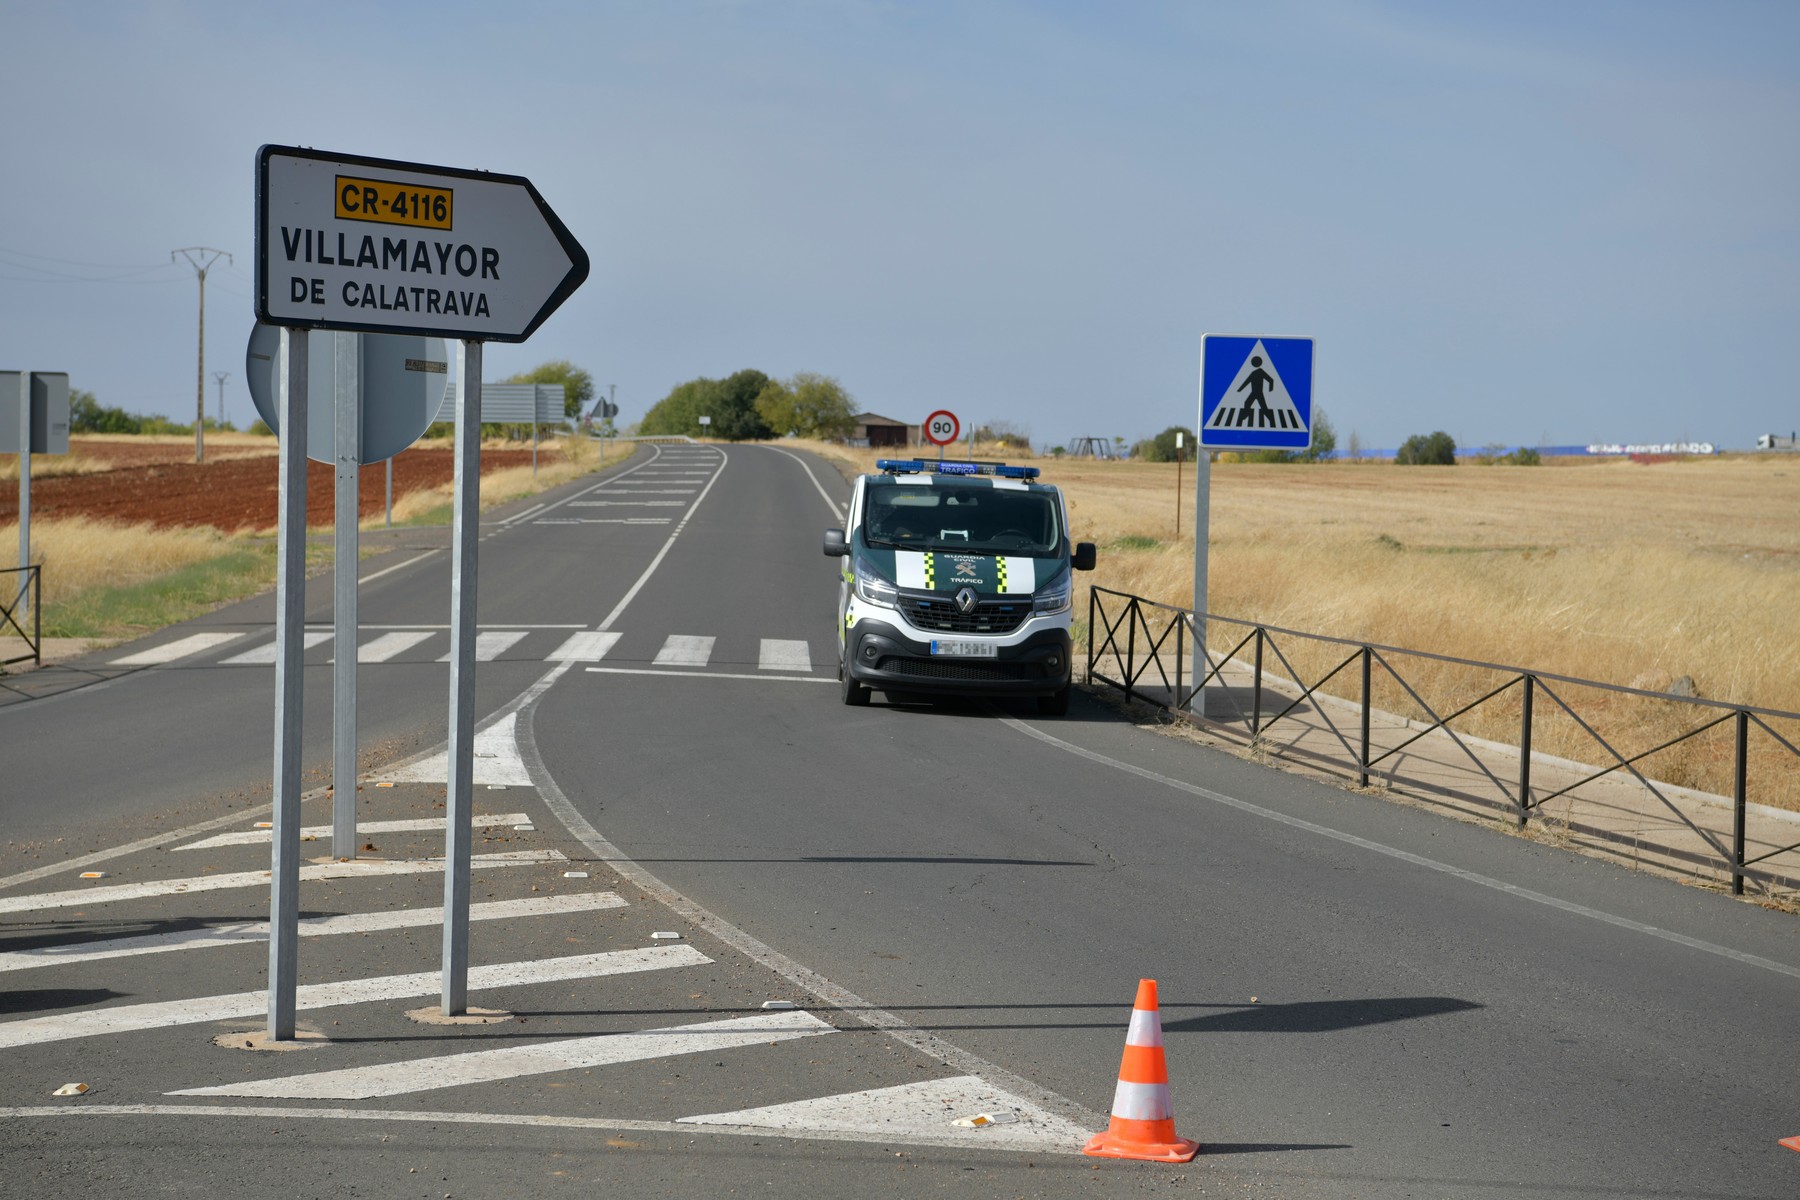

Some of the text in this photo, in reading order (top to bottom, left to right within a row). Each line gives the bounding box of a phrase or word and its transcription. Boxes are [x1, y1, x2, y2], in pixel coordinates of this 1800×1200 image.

[341, 184, 447, 222] CR-4116
[281, 226, 500, 280] VILLAMAYOR
[290, 276, 491, 318] DE CALATRAVA
[933, 422, 951, 433] 90
